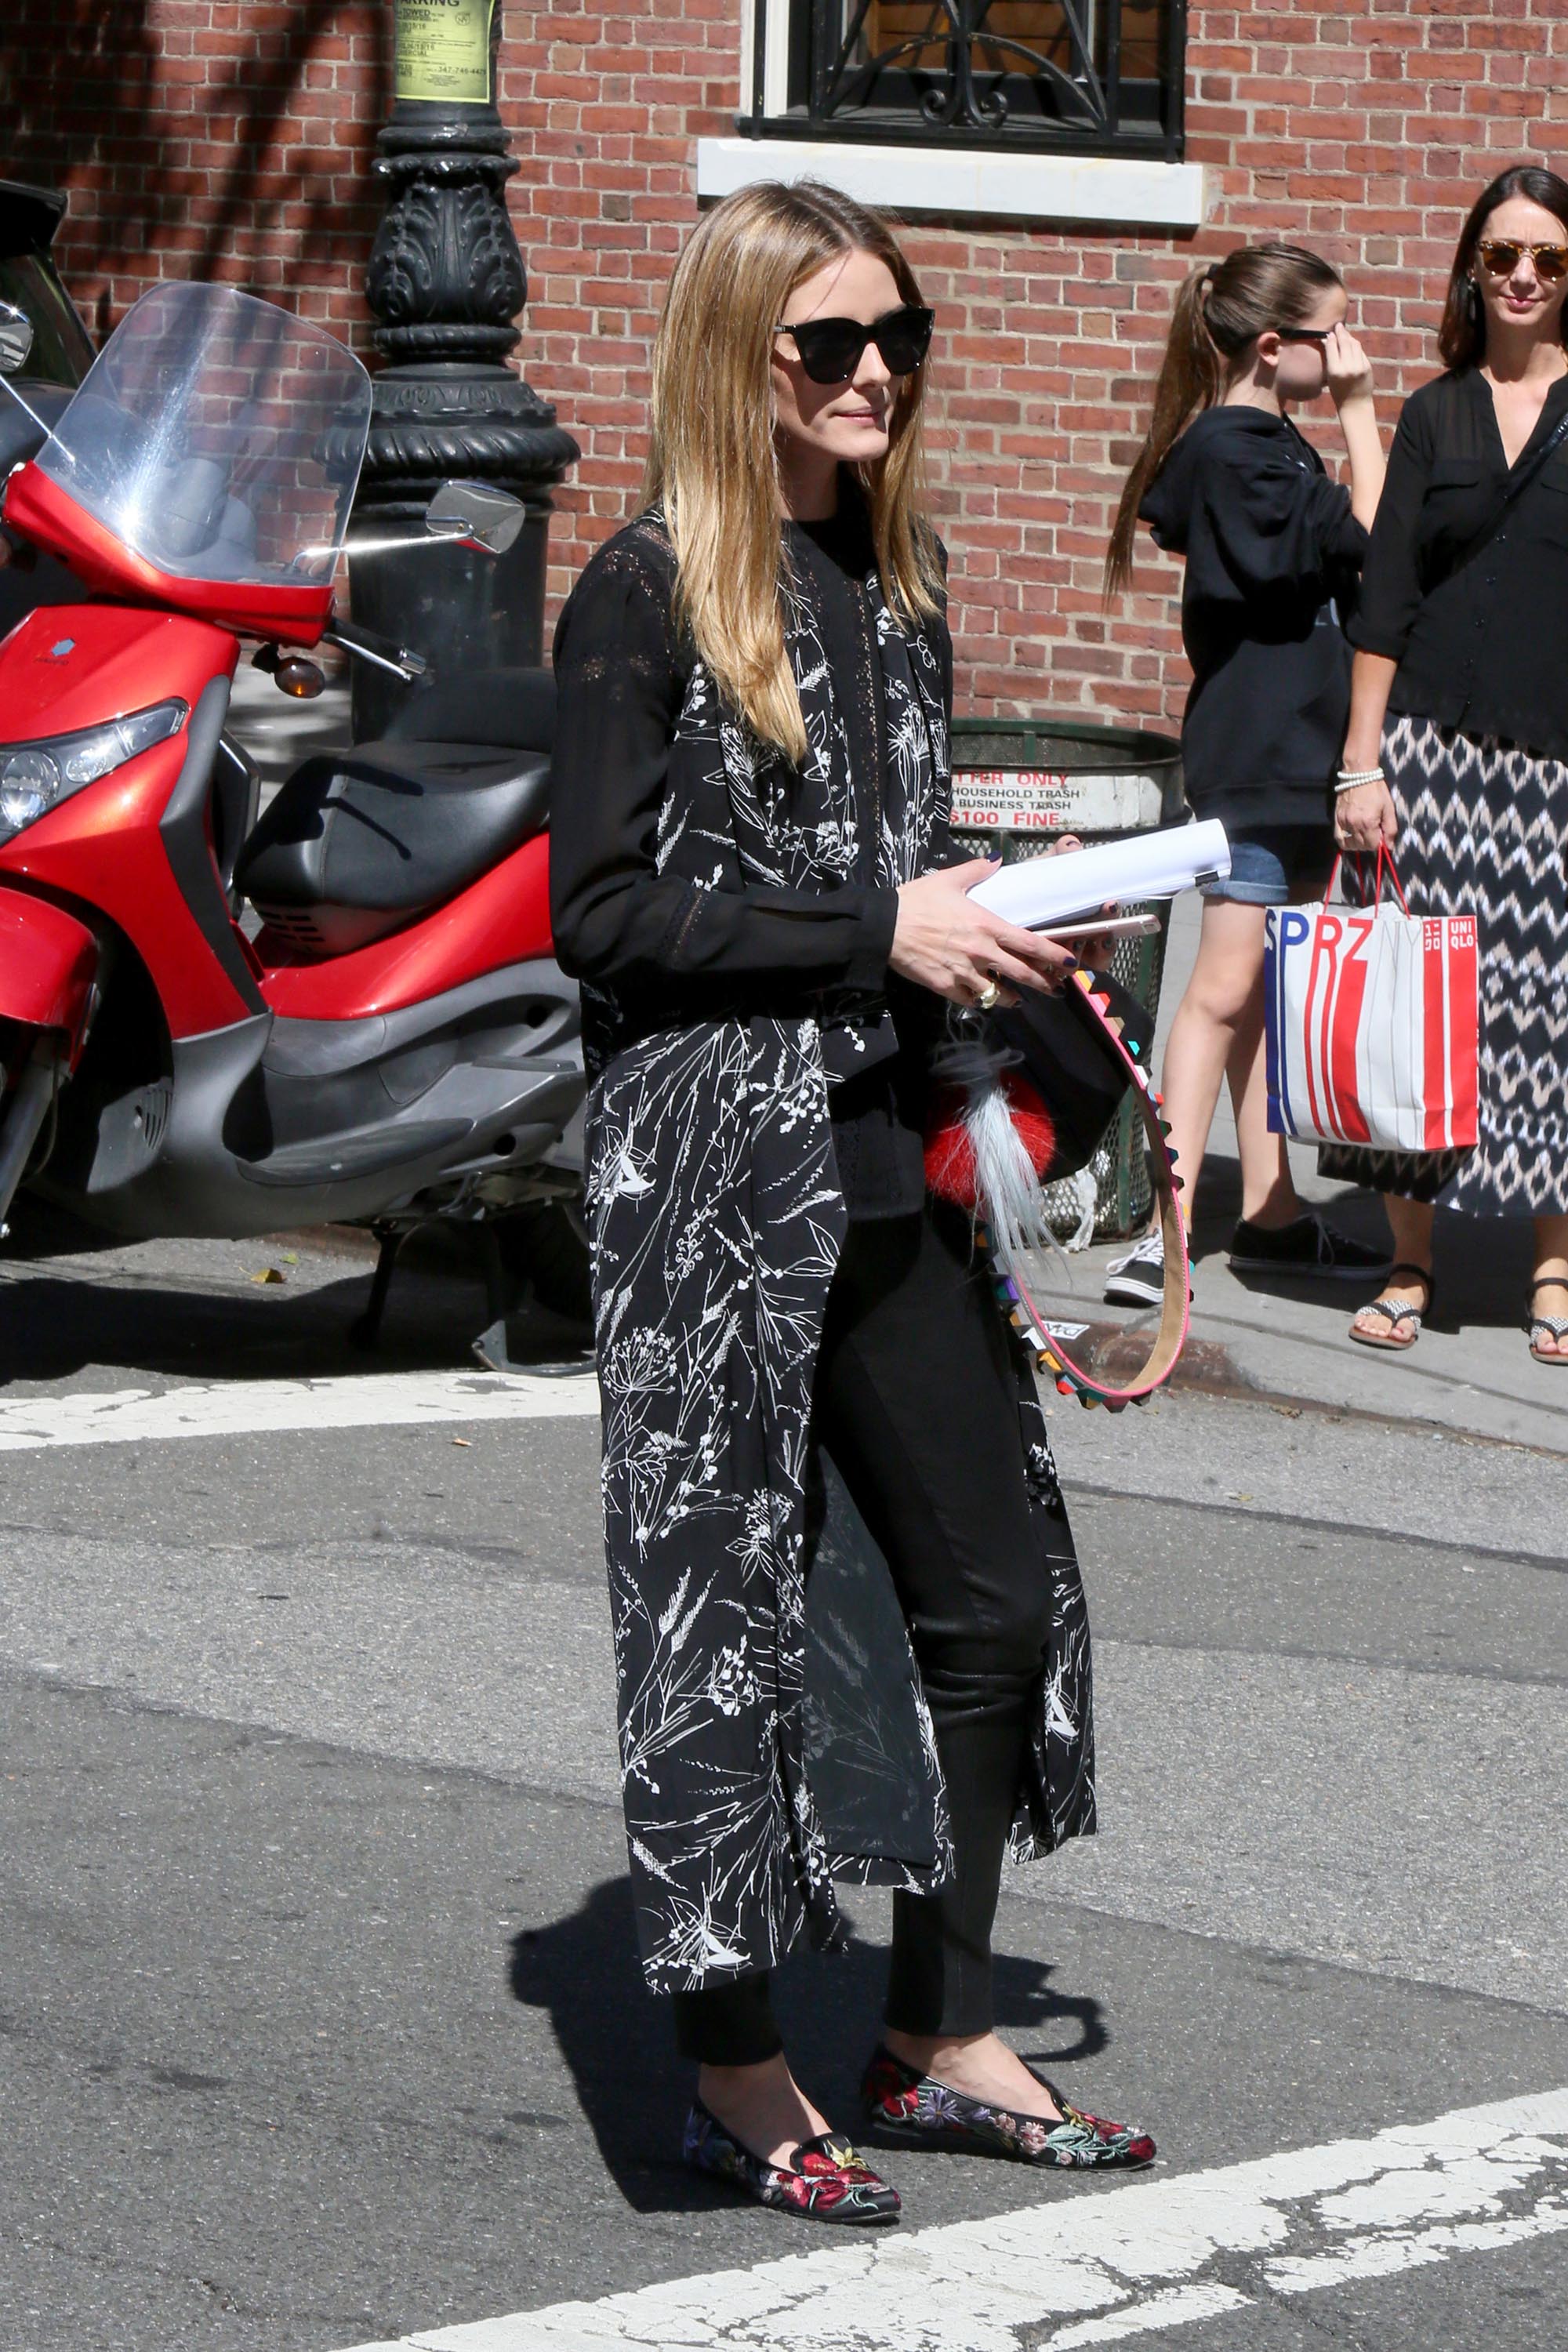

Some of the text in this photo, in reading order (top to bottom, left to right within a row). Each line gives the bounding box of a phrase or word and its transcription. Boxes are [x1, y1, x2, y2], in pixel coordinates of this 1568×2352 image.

[1016, 771, 1069, 787] ONLY
[952, 787, 1080, 798] HOUSEHOLD TRASH
[959, 799, 1071, 810] BUSINESS TRASH
[950, 810, 1059, 826] $100 FINE
